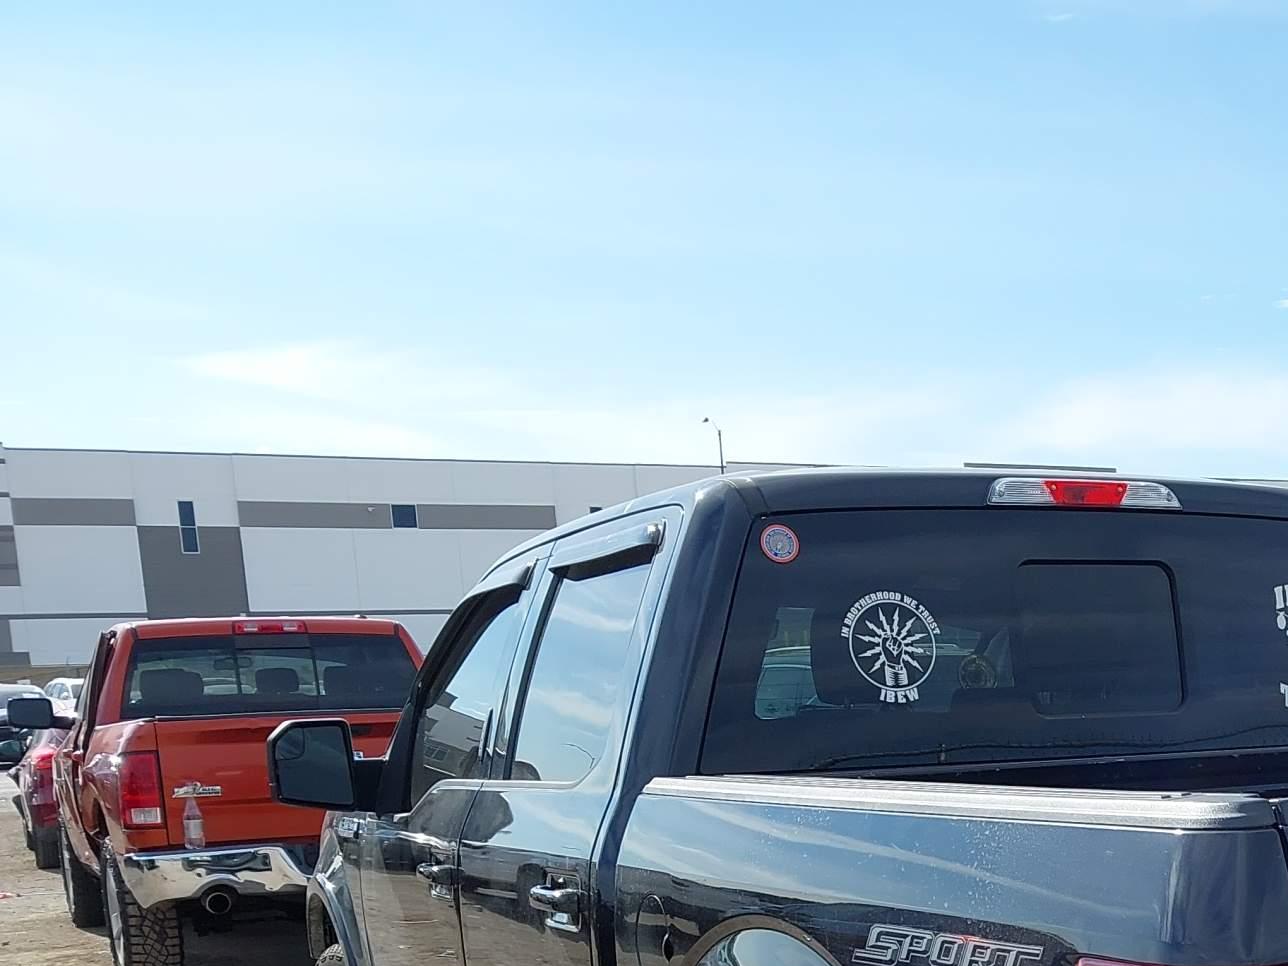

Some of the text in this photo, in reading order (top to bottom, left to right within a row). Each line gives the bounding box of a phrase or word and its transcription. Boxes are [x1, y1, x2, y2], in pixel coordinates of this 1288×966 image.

[840, 591, 941, 638] IN BROTHERHOOD WE TRUST
[879, 687, 919, 703] IBEW
